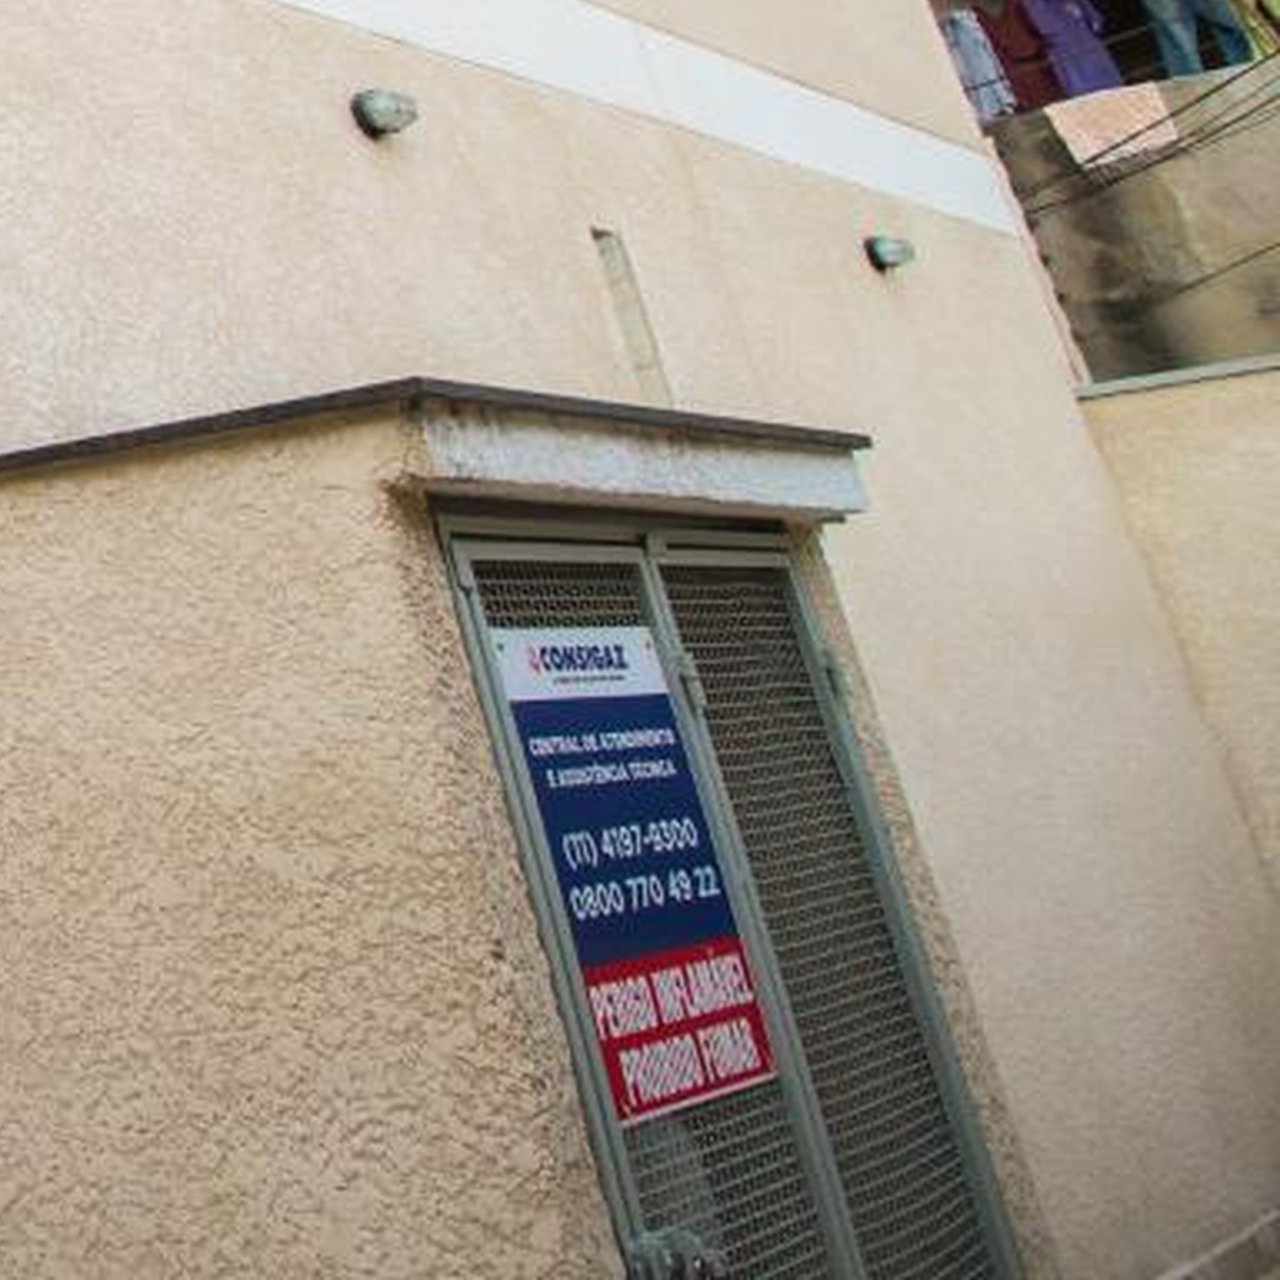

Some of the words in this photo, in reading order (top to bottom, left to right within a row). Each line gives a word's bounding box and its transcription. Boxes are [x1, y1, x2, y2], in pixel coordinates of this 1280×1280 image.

[539, 644, 629, 671] CONSIGAZ
[569, 880, 625, 921] 0800
[625, 874, 665, 914] 770
[693, 865, 721, 898] 22
